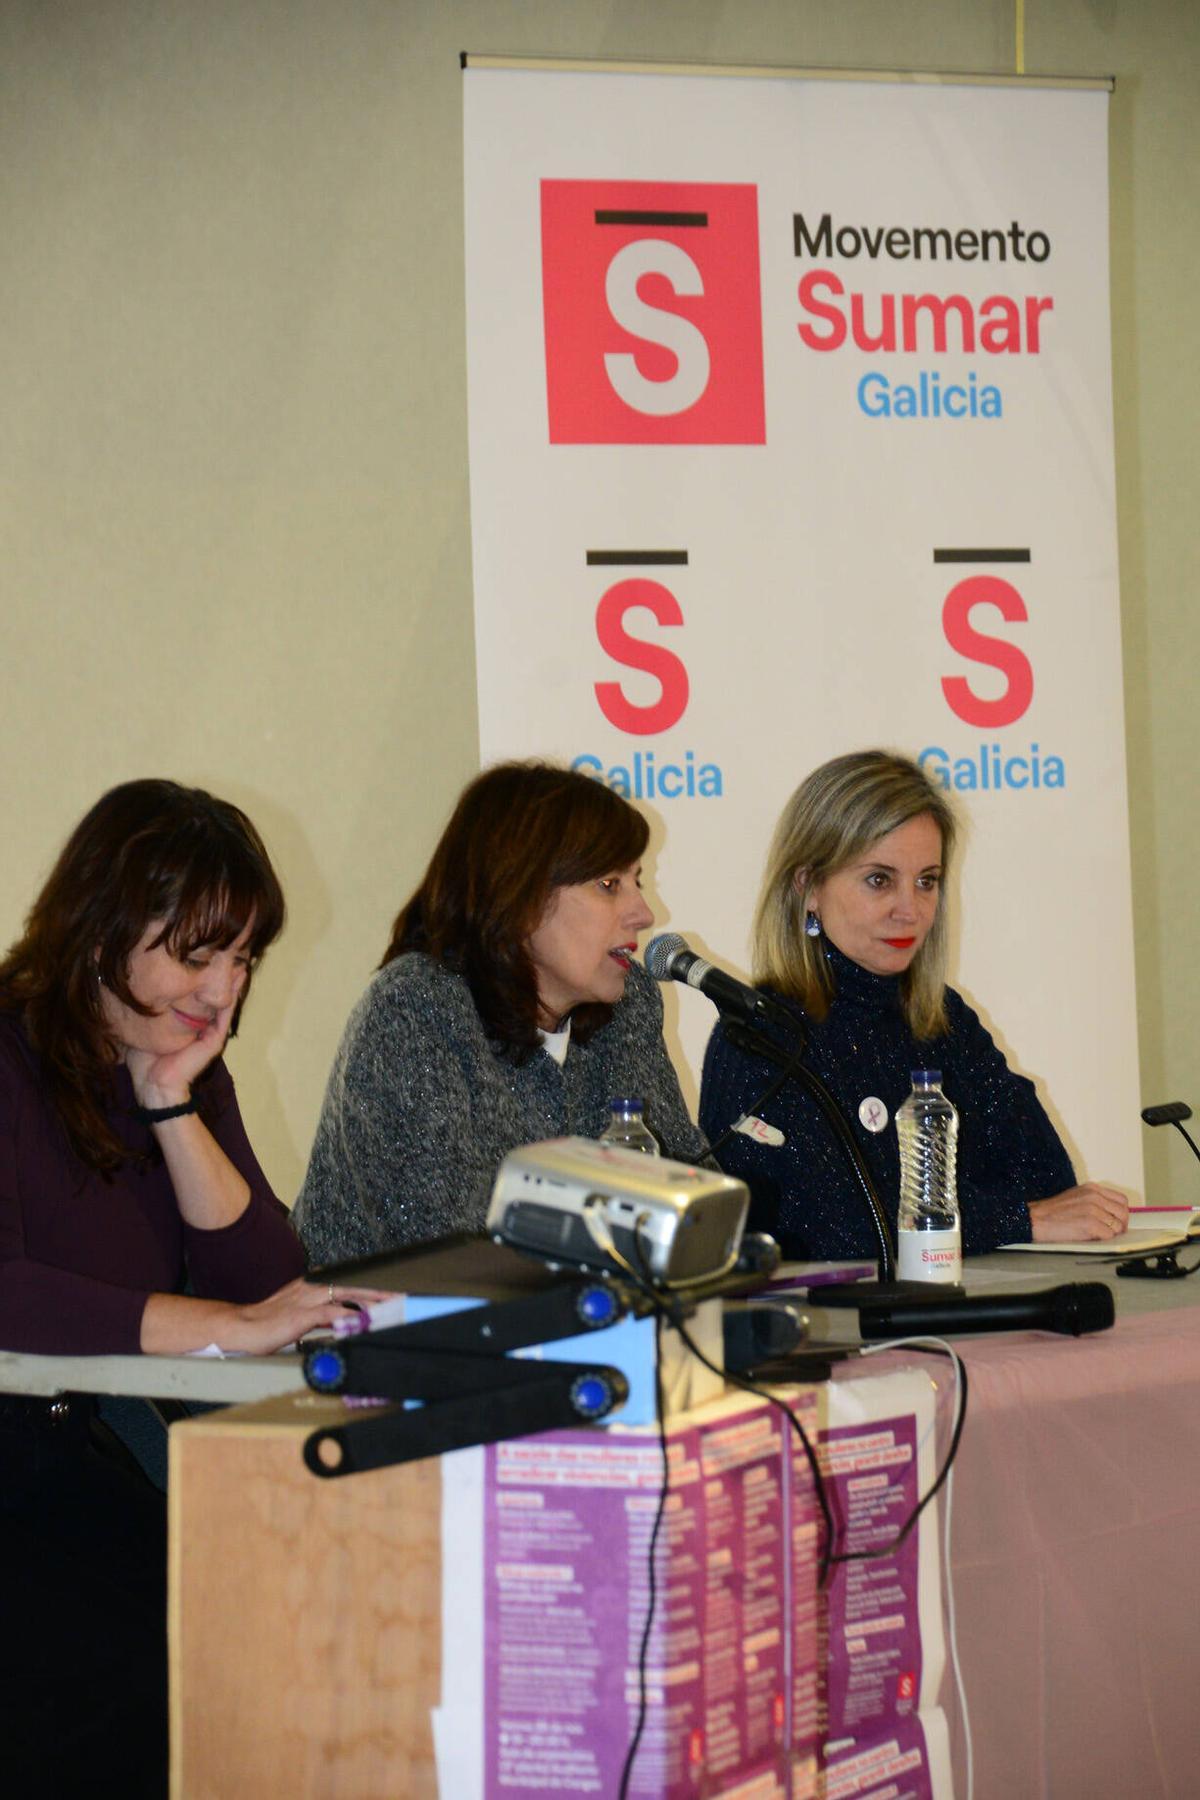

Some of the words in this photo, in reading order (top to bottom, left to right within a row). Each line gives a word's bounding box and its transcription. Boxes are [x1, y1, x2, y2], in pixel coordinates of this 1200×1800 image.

[793, 213, 1051, 263] Movemento
[603, 238, 711, 417] S
[797, 269, 1053, 355] Sumar
[857, 371, 1003, 419] Galicia
[593, 577, 690, 736] S
[940, 574, 1035, 729] S
[917, 742, 1066, 791] Galicia
